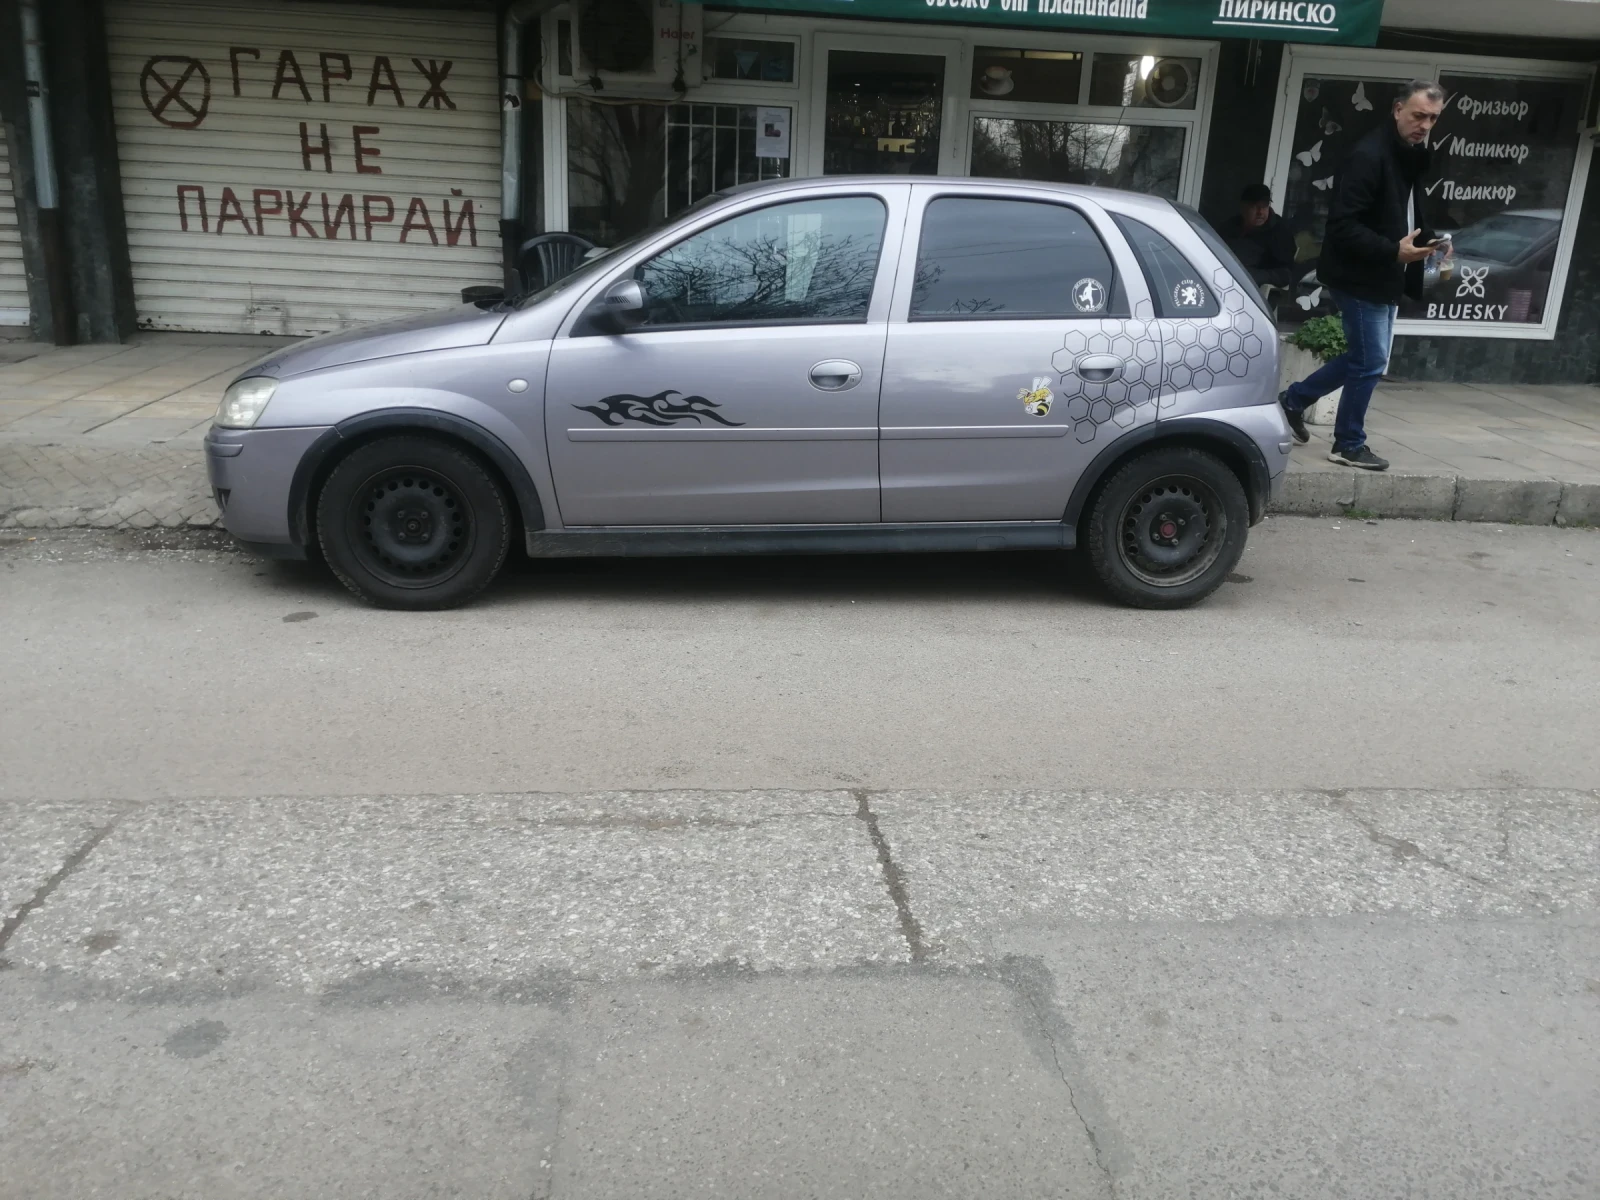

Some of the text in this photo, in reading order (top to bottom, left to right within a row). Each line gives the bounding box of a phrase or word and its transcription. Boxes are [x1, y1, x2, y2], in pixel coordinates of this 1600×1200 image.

[1218, 0, 1336, 24] ПИРИНСКО
[229, 47, 457, 110] ГАРАЖ
[1457, 95, 1529, 120] Фризьор
[299, 122, 382, 174] НЕ
[1449, 136, 1529, 164] Маникюр
[1442, 180, 1517, 204] Педикюр
[176, 185, 477, 247] ПАРКИРАЙ
[1426, 302, 1508, 320] BLUESKY
